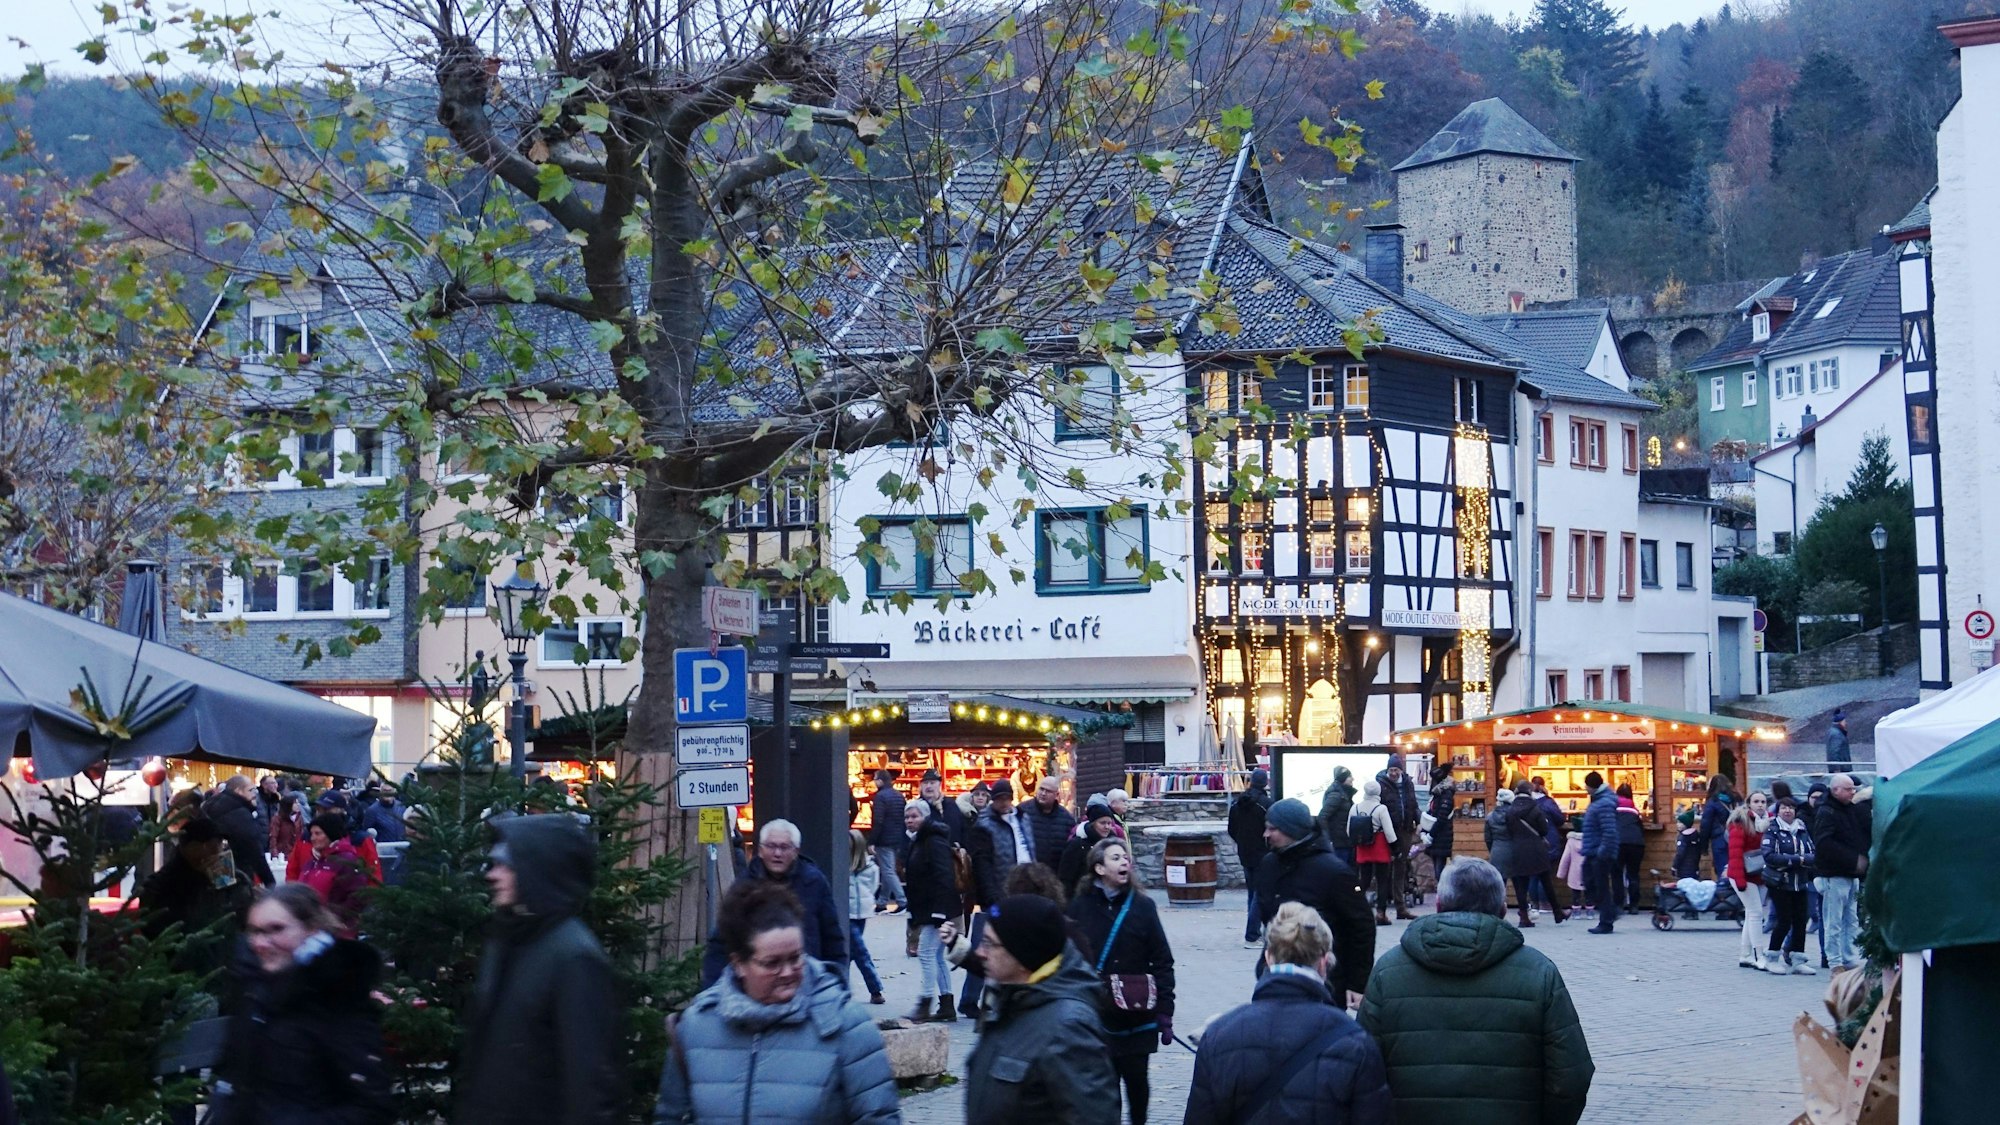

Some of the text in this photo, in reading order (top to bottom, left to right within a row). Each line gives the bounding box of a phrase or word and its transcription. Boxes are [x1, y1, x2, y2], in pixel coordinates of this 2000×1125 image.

[1242, 600, 1331, 609] MODE OUTLET
[1385, 613, 1404, 624] MODE
[1405, 613, 1430, 625] OUTLET
[914, 618, 1024, 644] Bäckerei
[1050, 615, 1102, 643] Café
[693, 660, 730, 713] P
[1552, 725, 1595, 735] Printenhaus
[682, 735, 744, 748] gebührenpflichtig
[689, 780, 739, 795] 2 Stunden
